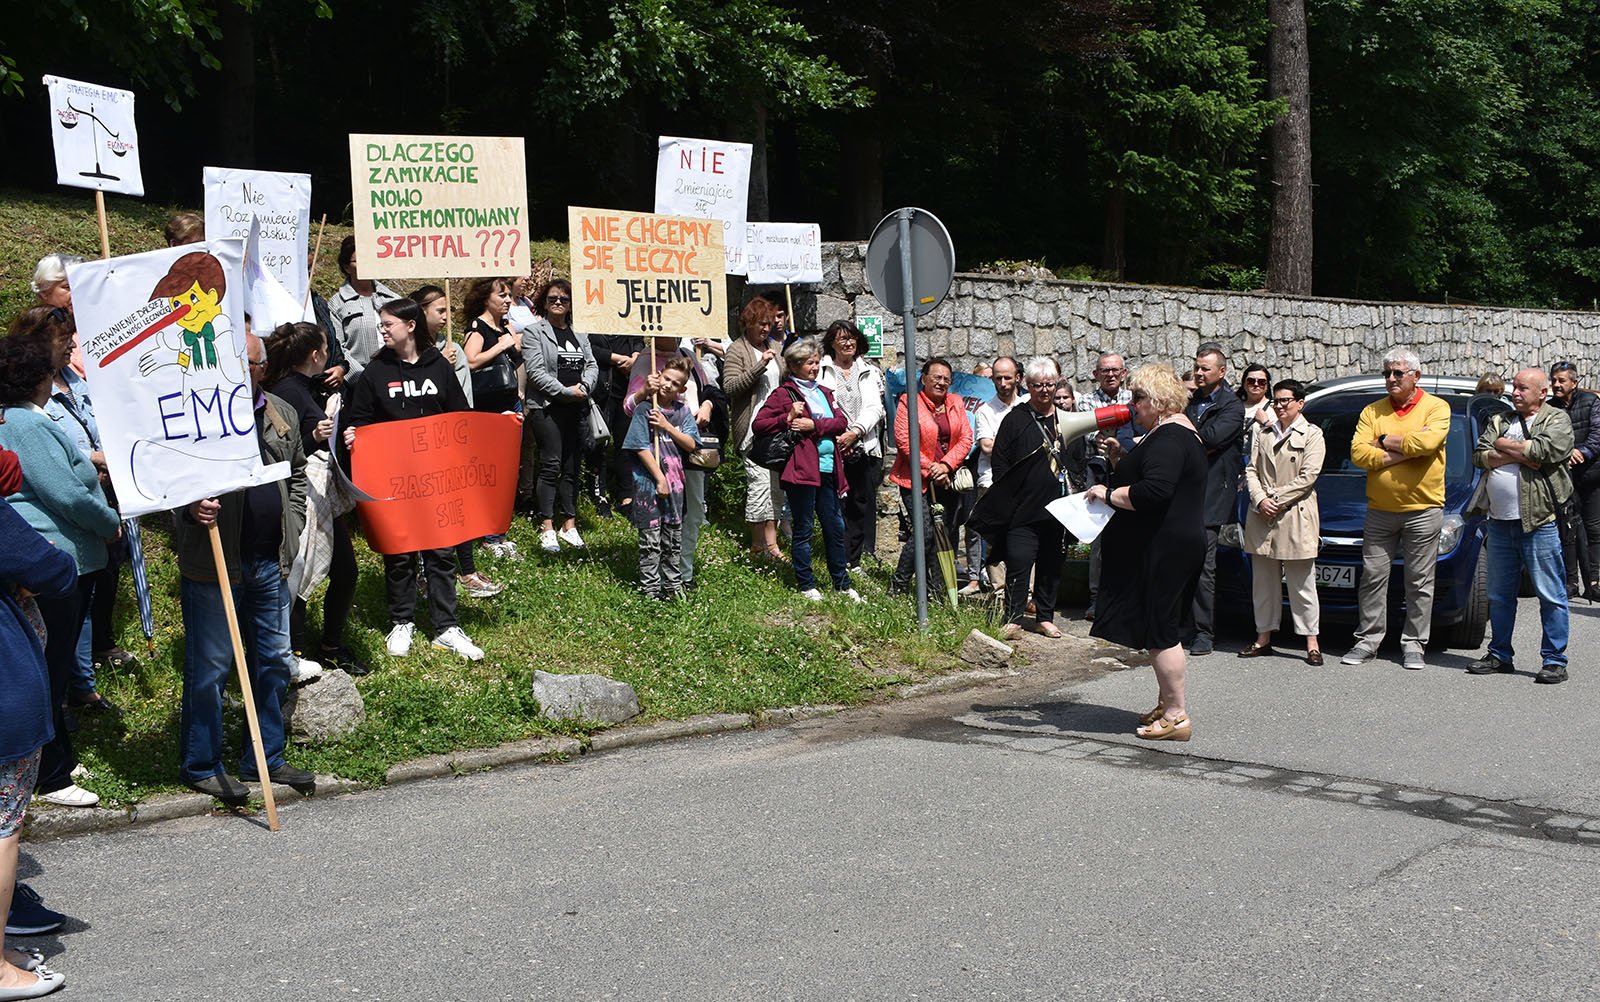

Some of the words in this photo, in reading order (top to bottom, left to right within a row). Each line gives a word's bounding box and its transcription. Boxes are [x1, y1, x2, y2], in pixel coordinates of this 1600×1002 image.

[66, 83, 101, 99] STRATEGIA
[102, 89, 119, 104] EMC
[366, 142, 474, 164] DLACZEGO
[368, 166, 478, 184] ZAMYKACIE
[243, 182, 266, 206] Nie
[370, 188, 423, 208] NOWO
[372, 206, 520, 230] WYREMONTOWANY
[580, 215, 621, 242] NIE
[625, 216, 712, 247] CHCEMY
[376, 234, 470, 259] SZPITAL
[475, 228, 521, 268] ???
[582, 245, 614, 273] SIĘ
[624, 245, 699, 275] LECZYĆ
[585, 278, 605, 305] W
[616, 278, 713, 319] JELENIEJ
[82, 312, 139, 355] ZAPEWNIENIE
[136, 298, 164, 319] DALSZEJ
[143, 304, 172, 326] LECZNICZEJ
[639, 304, 664, 332] !!!
[387, 378, 439, 399] FILA
[158, 383, 256, 445] EMC
[410, 418, 468, 454] EMC
[389, 456, 497, 501] ZASTANÓW
[436, 498, 465, 530] SIĘ
